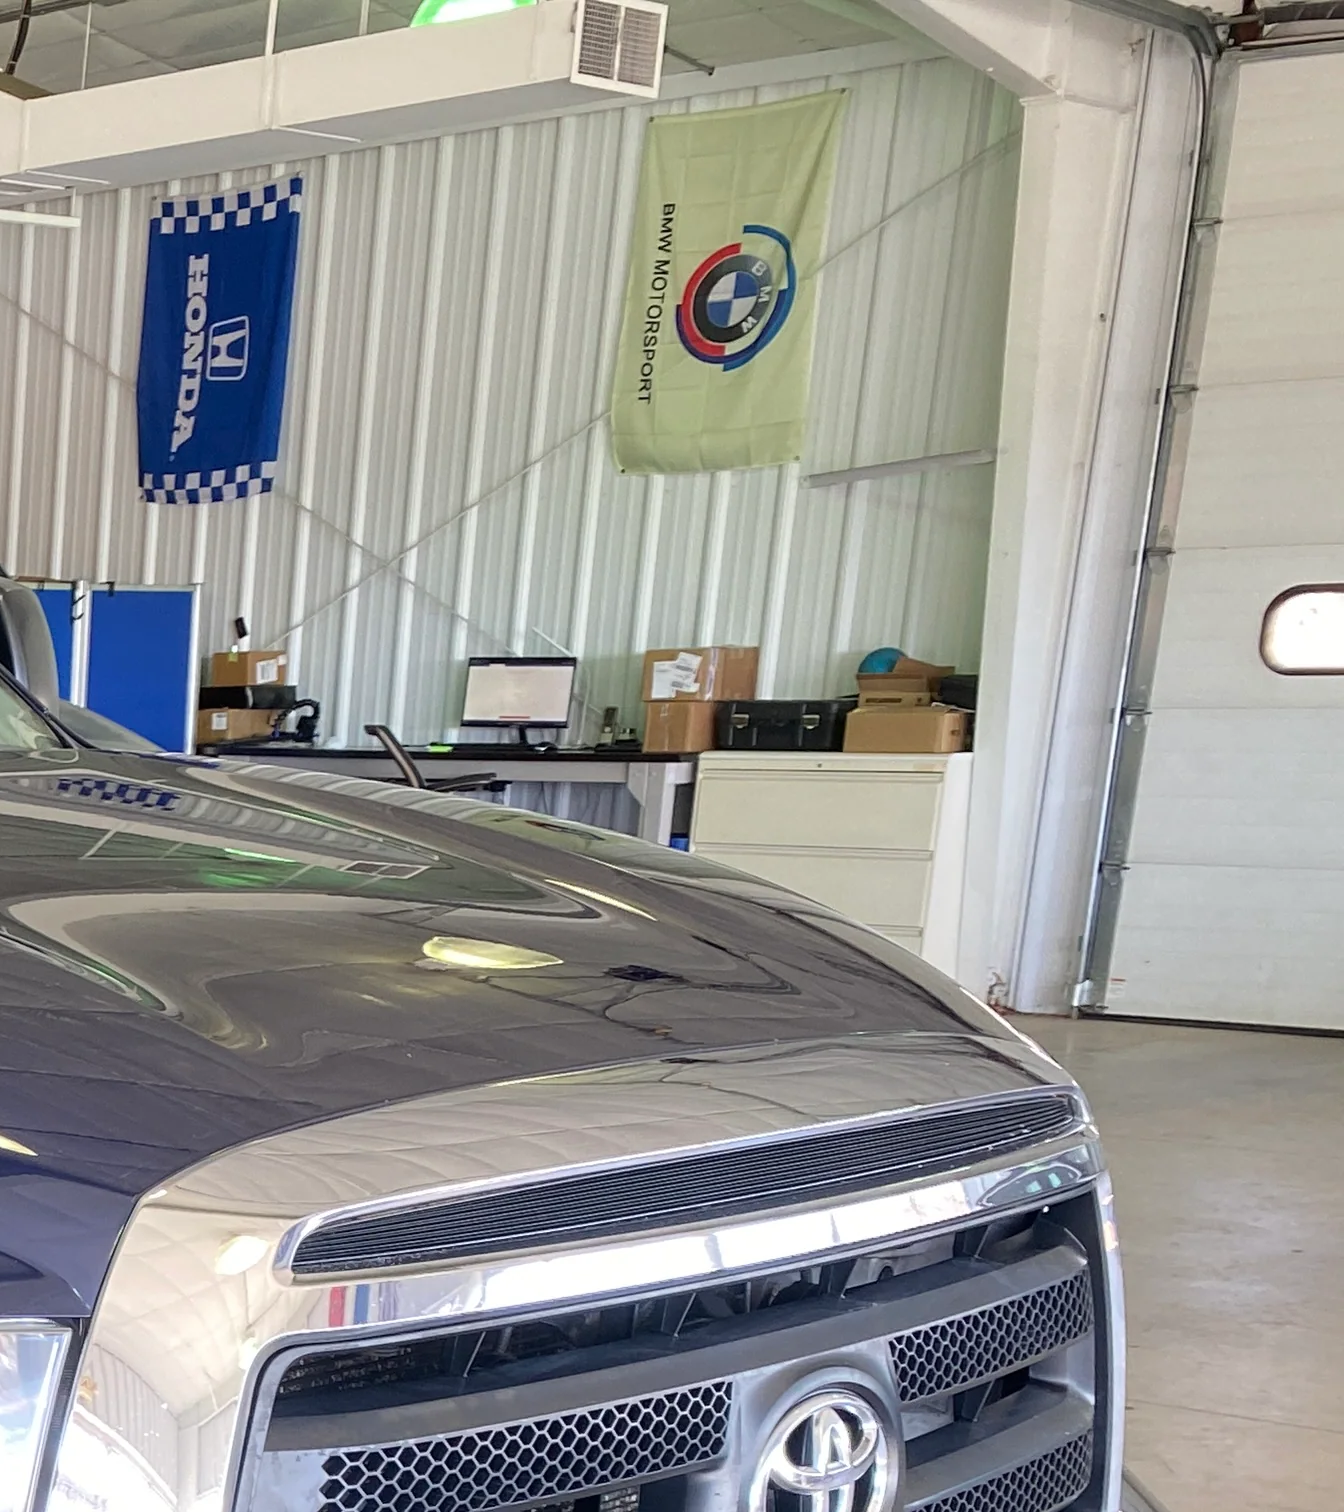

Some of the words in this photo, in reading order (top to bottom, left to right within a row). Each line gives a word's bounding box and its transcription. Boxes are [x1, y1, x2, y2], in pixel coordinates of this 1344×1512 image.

[659, 203, 676, 253] BMW
[638, 259, 671, 405] MOTORSPORT
[741, 260, 773, 334] BMW
[170, 254, 209, 453] HONDA
